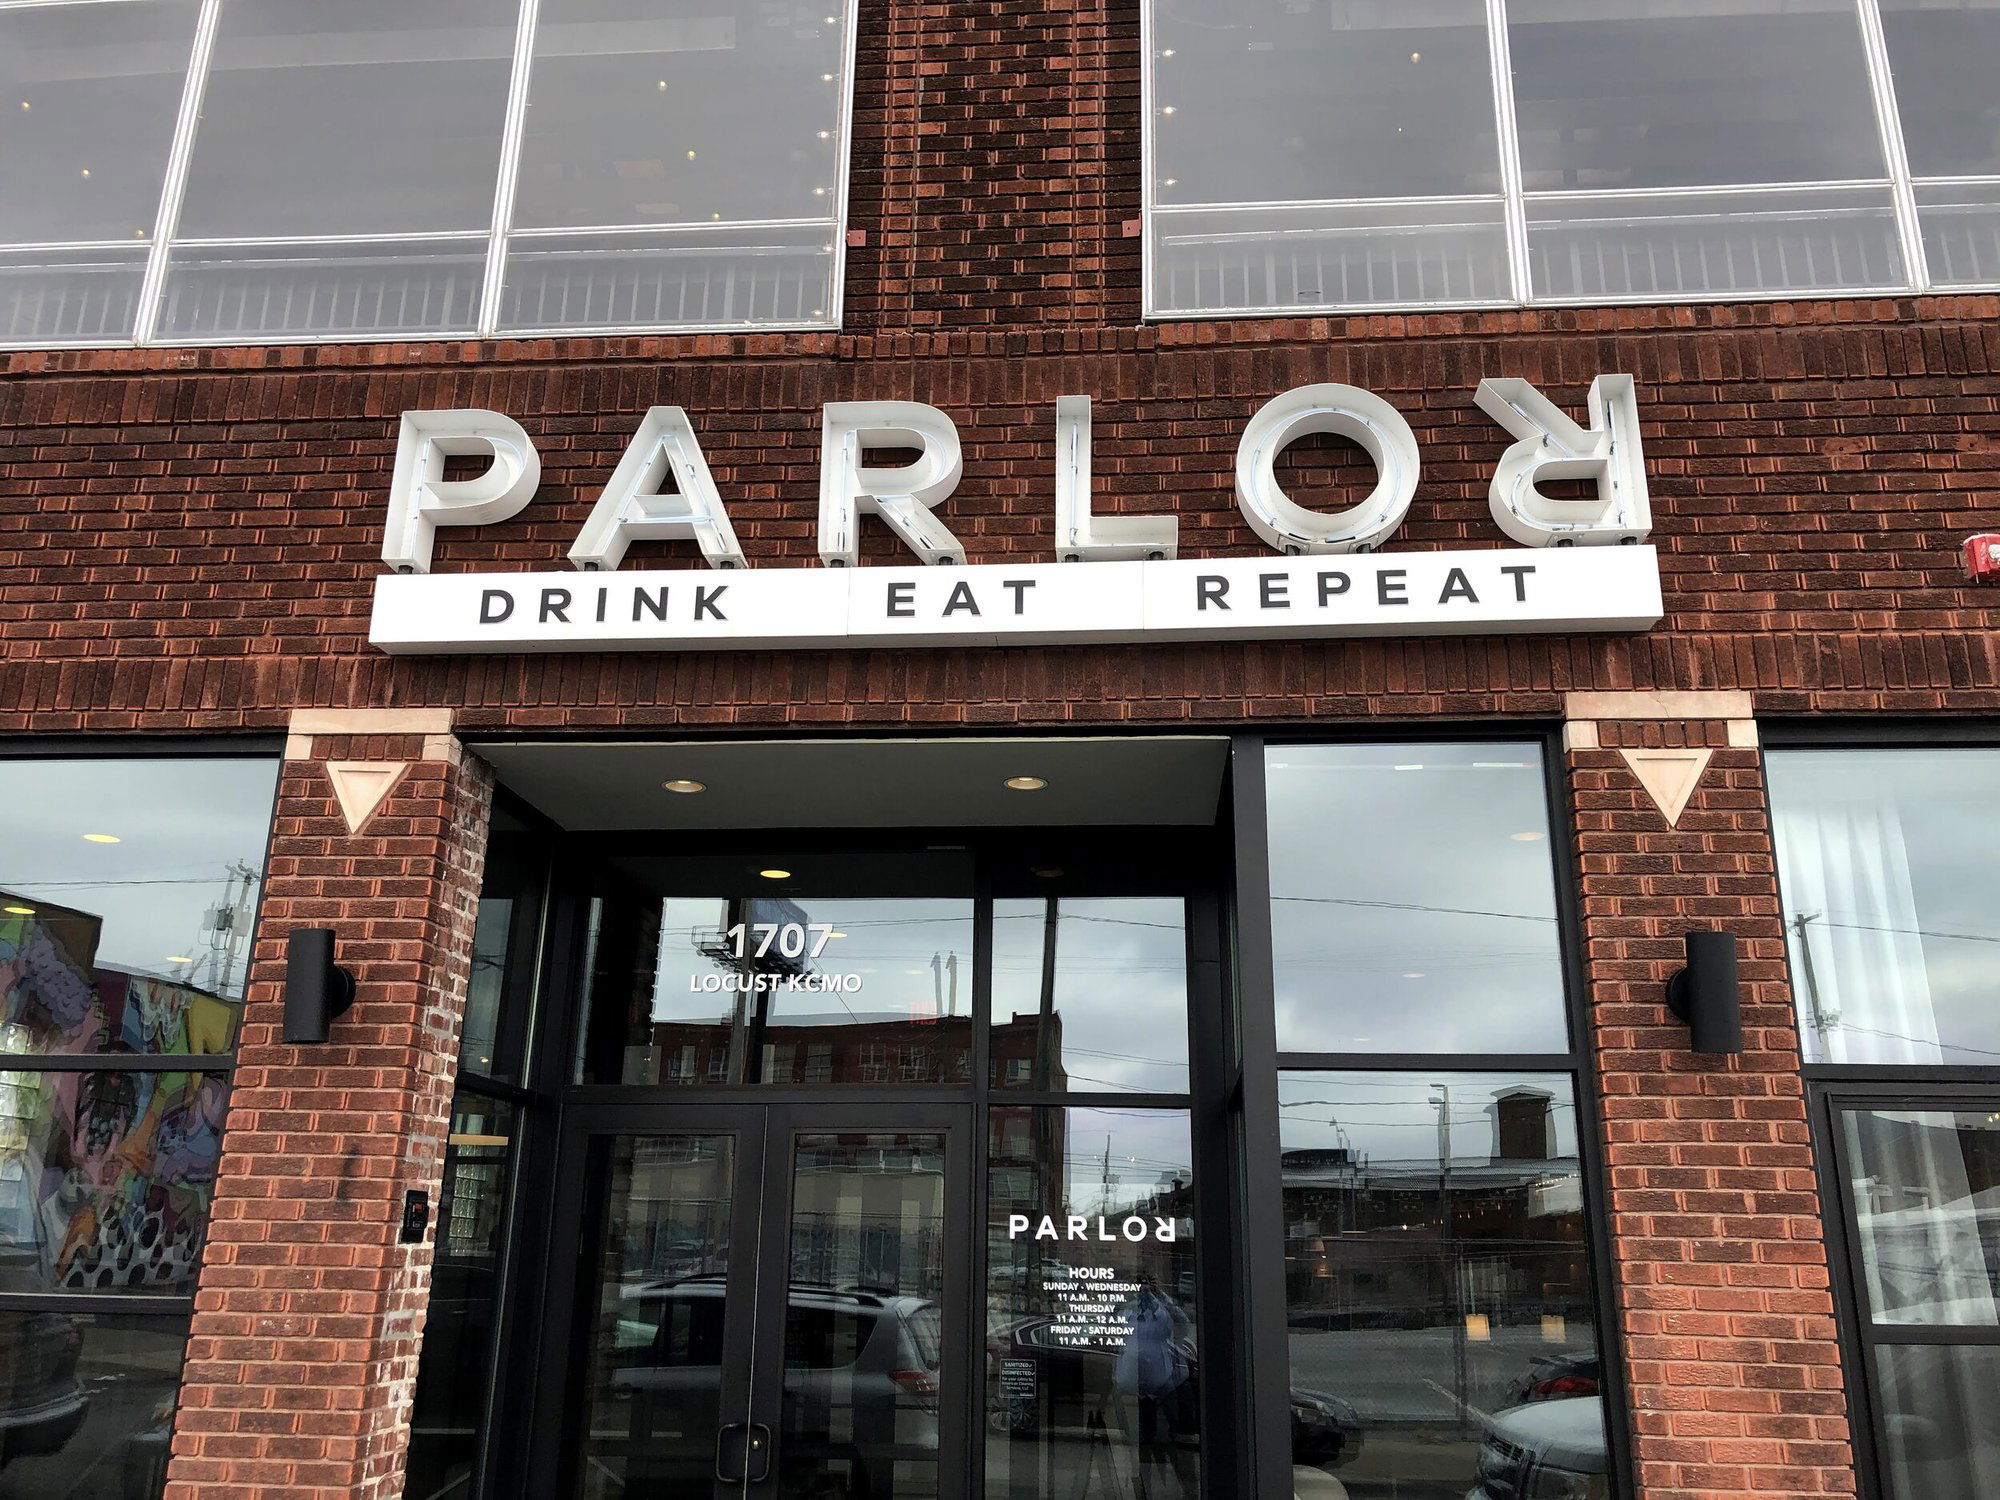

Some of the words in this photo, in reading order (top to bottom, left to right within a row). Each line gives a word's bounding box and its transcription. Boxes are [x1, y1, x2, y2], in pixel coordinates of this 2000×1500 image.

[381, 374, 1652, 573] PARLOR
[479, 585, 729, 624] DRINK
[887, 580, 1037, 617] EAT
[1197, 565, 1536, 611] REPEAT
[727, 923, 834, 958] 1707
[690, 973, 783, 992] LOCUST
[789, 973, 862, 993] KCMO
[1009, 1214, 1176, 1242] PARLOR
[1069, 1267, 1115, 1279] HOURS
[1043, 1282, 1079, 1291] SUNDAY
[1085, 1282, 1141, 1292] WEDNESDAY
[1058, 1293, 1067, 1301] 11
[1070, 1293, 1090, 1302] A.M.
[1097, 1294, 1107, 1302] 10
[1069, 1304, 1115, 1313] THURSDAY
[1057, 1315, 1066, 1323] 11
[1069, 1315, 1089, 1323] A.M.
[1096, 1315, 1106, 1324] 12
[1108, 1316, 1128, 1324] A.M.
[1050, 1326, 1081, 1335] FRIDAY
[1088, 1326, 1134, 1335] SATURDAY
[1059, 1337, 1068, 1345] 11
[1071, 1337, 1091, 1346] A.M.
[1098, 1338, 1103, 1346] 1
[1106, 1338, 1126, 1346] A.M.
